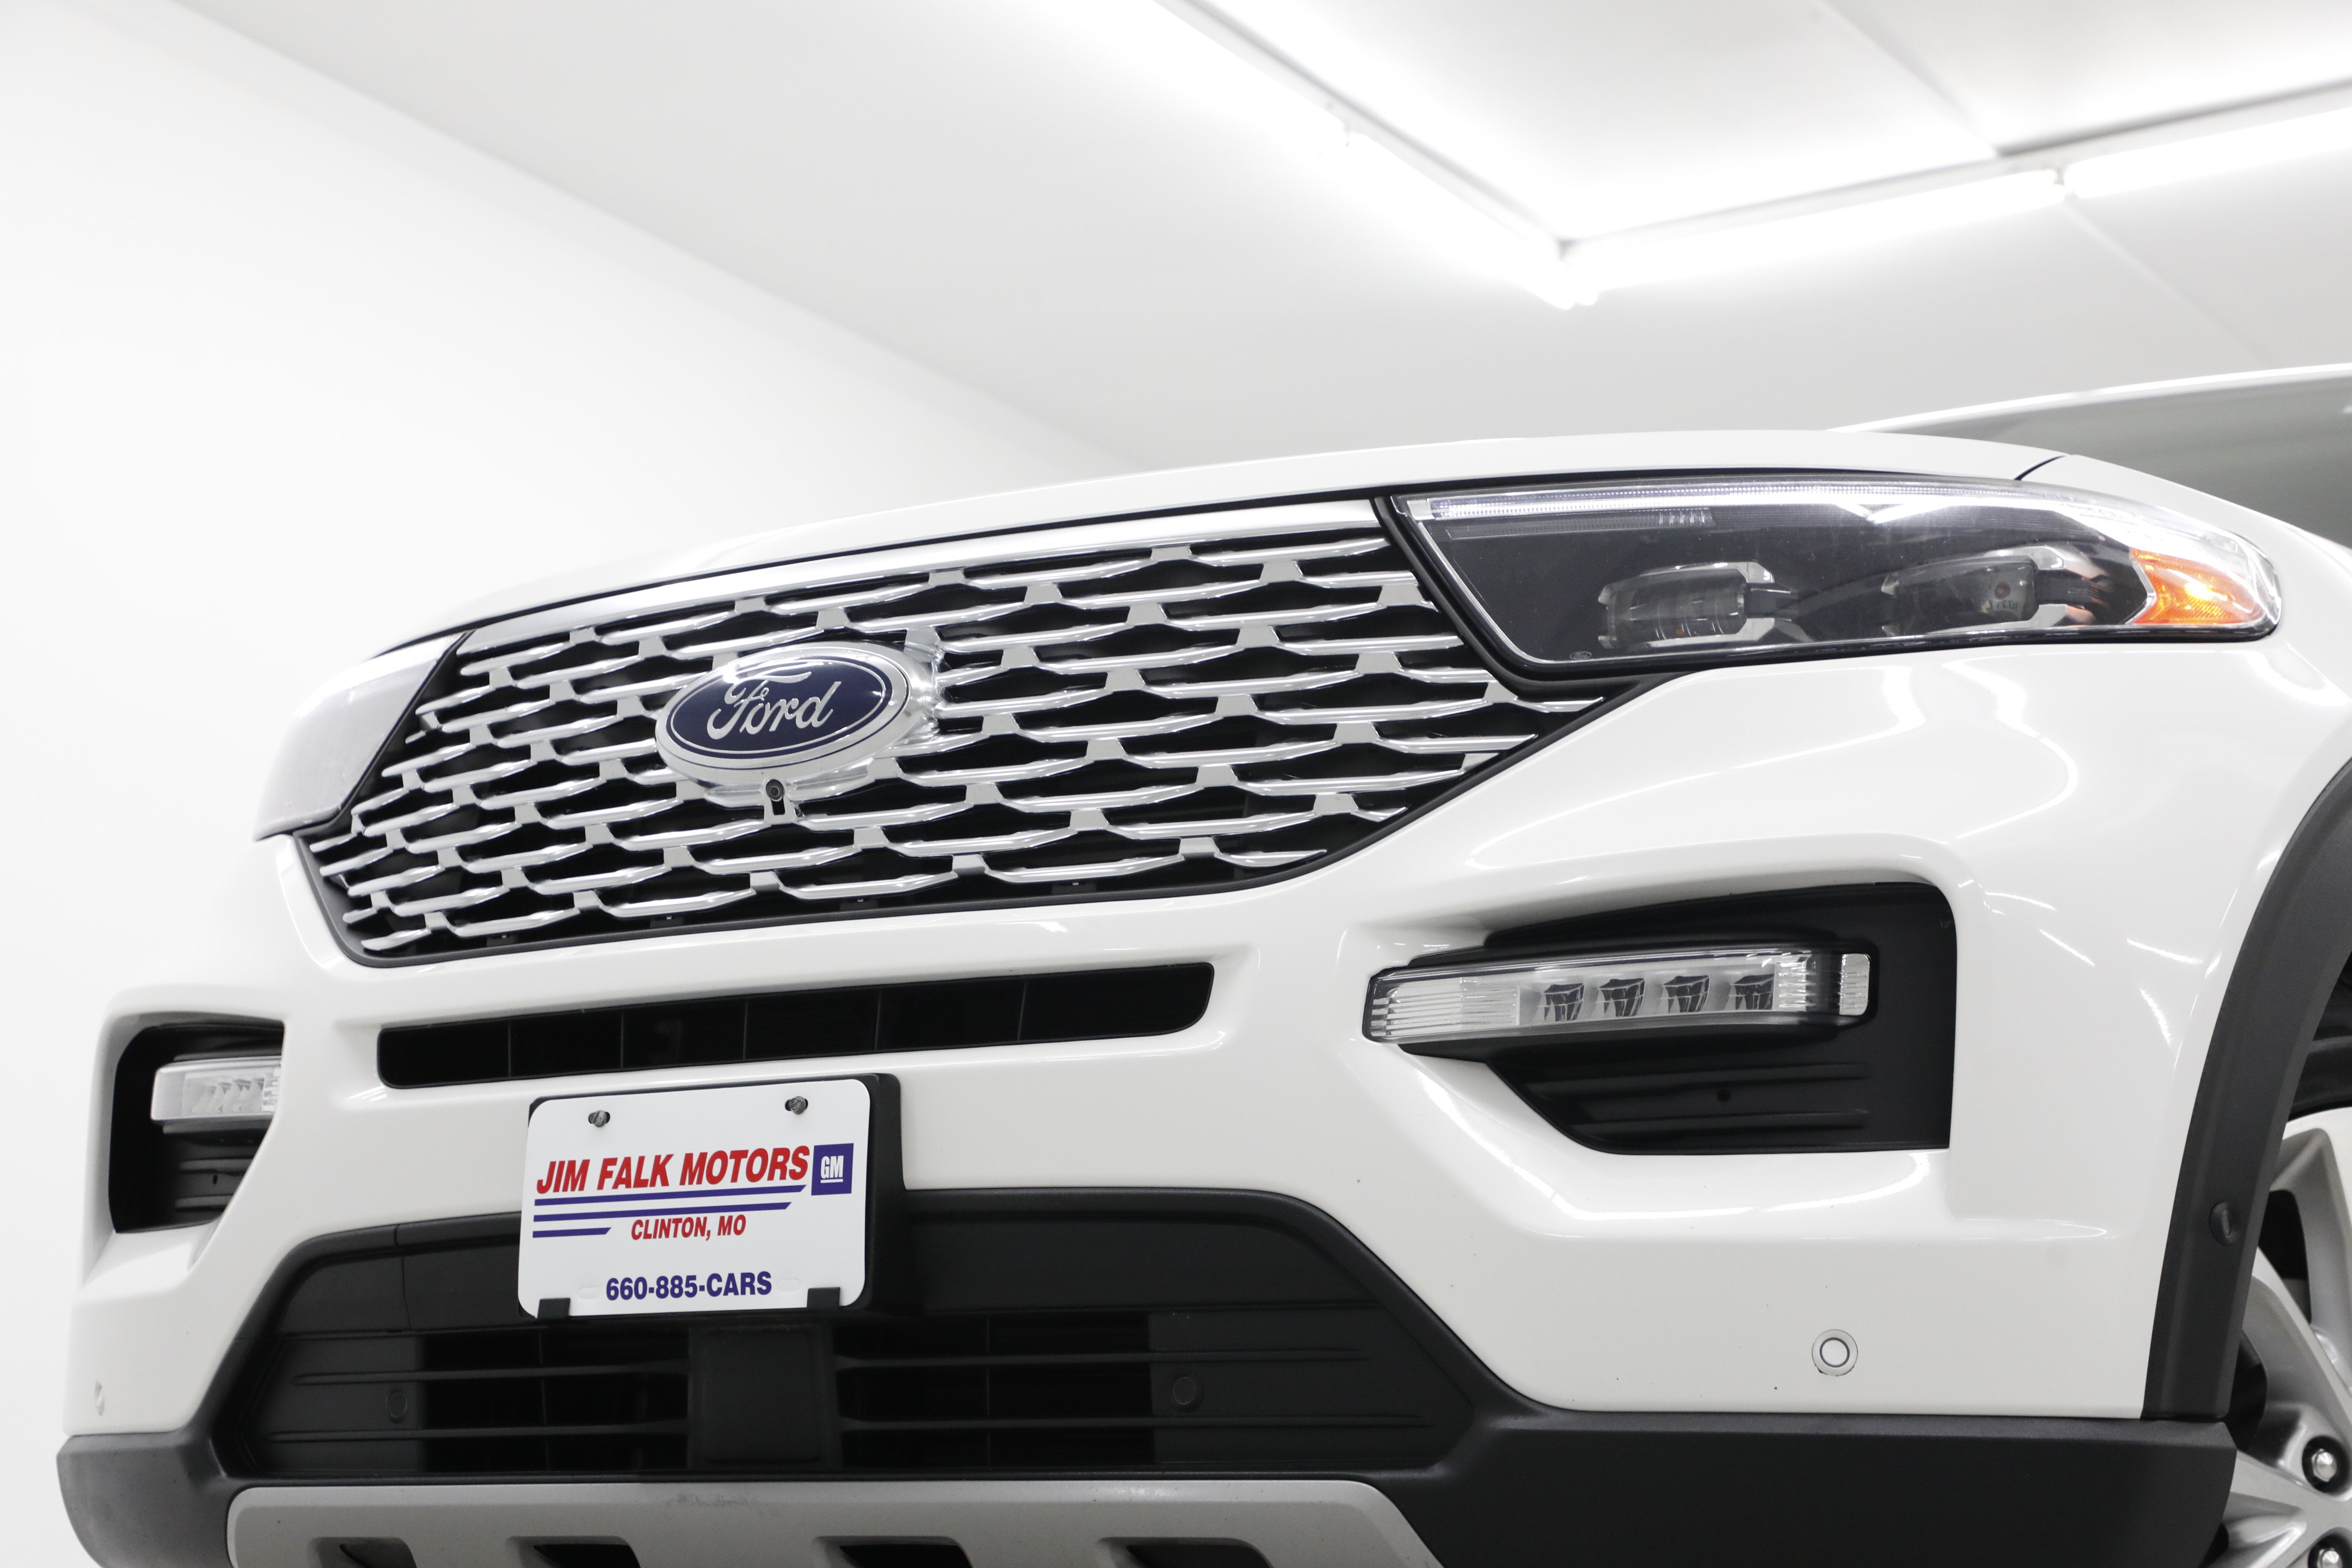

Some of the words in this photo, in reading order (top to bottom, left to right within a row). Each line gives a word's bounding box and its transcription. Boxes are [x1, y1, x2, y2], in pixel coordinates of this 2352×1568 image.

[707, 671, 842, 739] Ford
[537, 1159, 590, 1194] JIM
[597, 1154, 674, 1191] FALK
[679, 1145, 810, 1186] MOTORS
[820, 1155, 844, 1179] GM
[631, 1216, 711, 1241] CLINTON,
[718, 1214, 746, 1236] MO
[606, 1271, 772, 1301] 660-885-CARS
